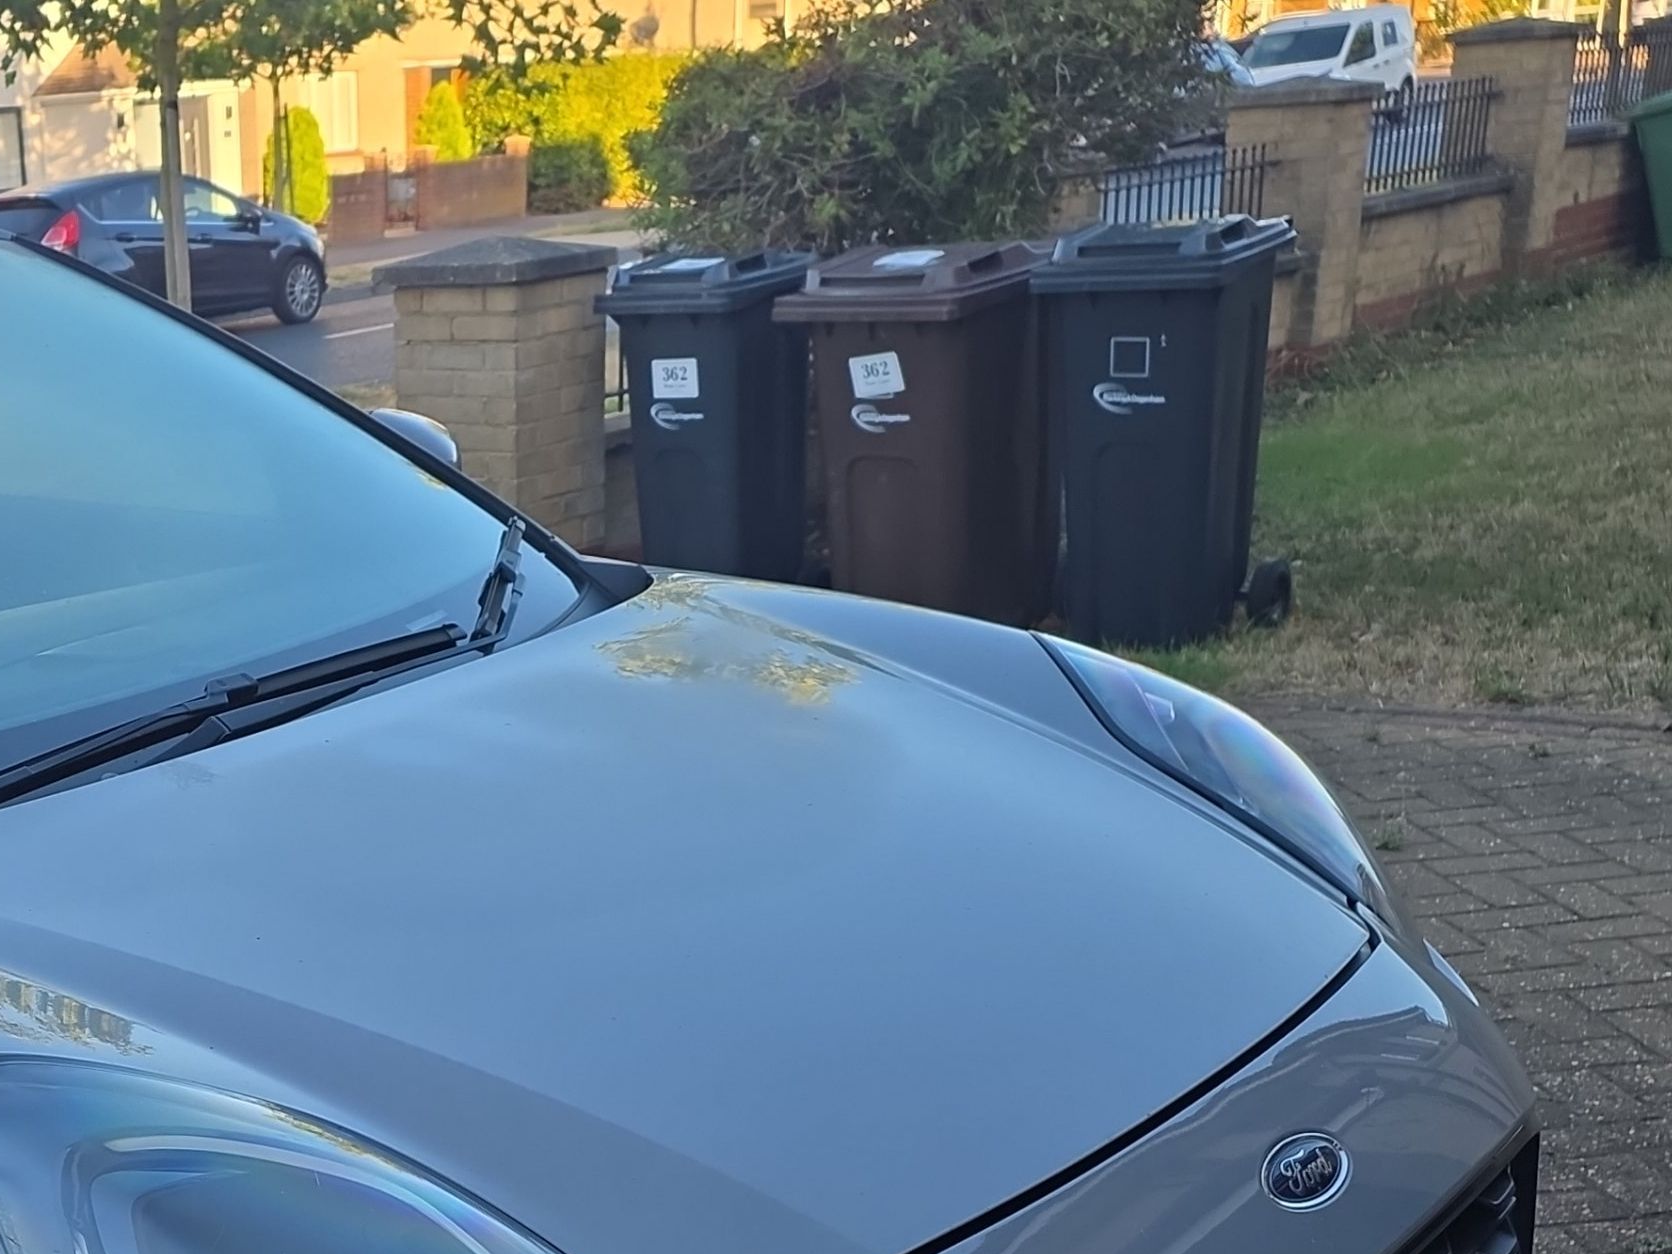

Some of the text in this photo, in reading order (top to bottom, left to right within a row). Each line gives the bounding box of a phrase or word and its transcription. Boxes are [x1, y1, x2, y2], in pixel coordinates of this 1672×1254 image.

[663, 366, 688, 382] 362
[862, 360, 890, 379] 362
[1280, 1148, 1332, 1191] Ford
